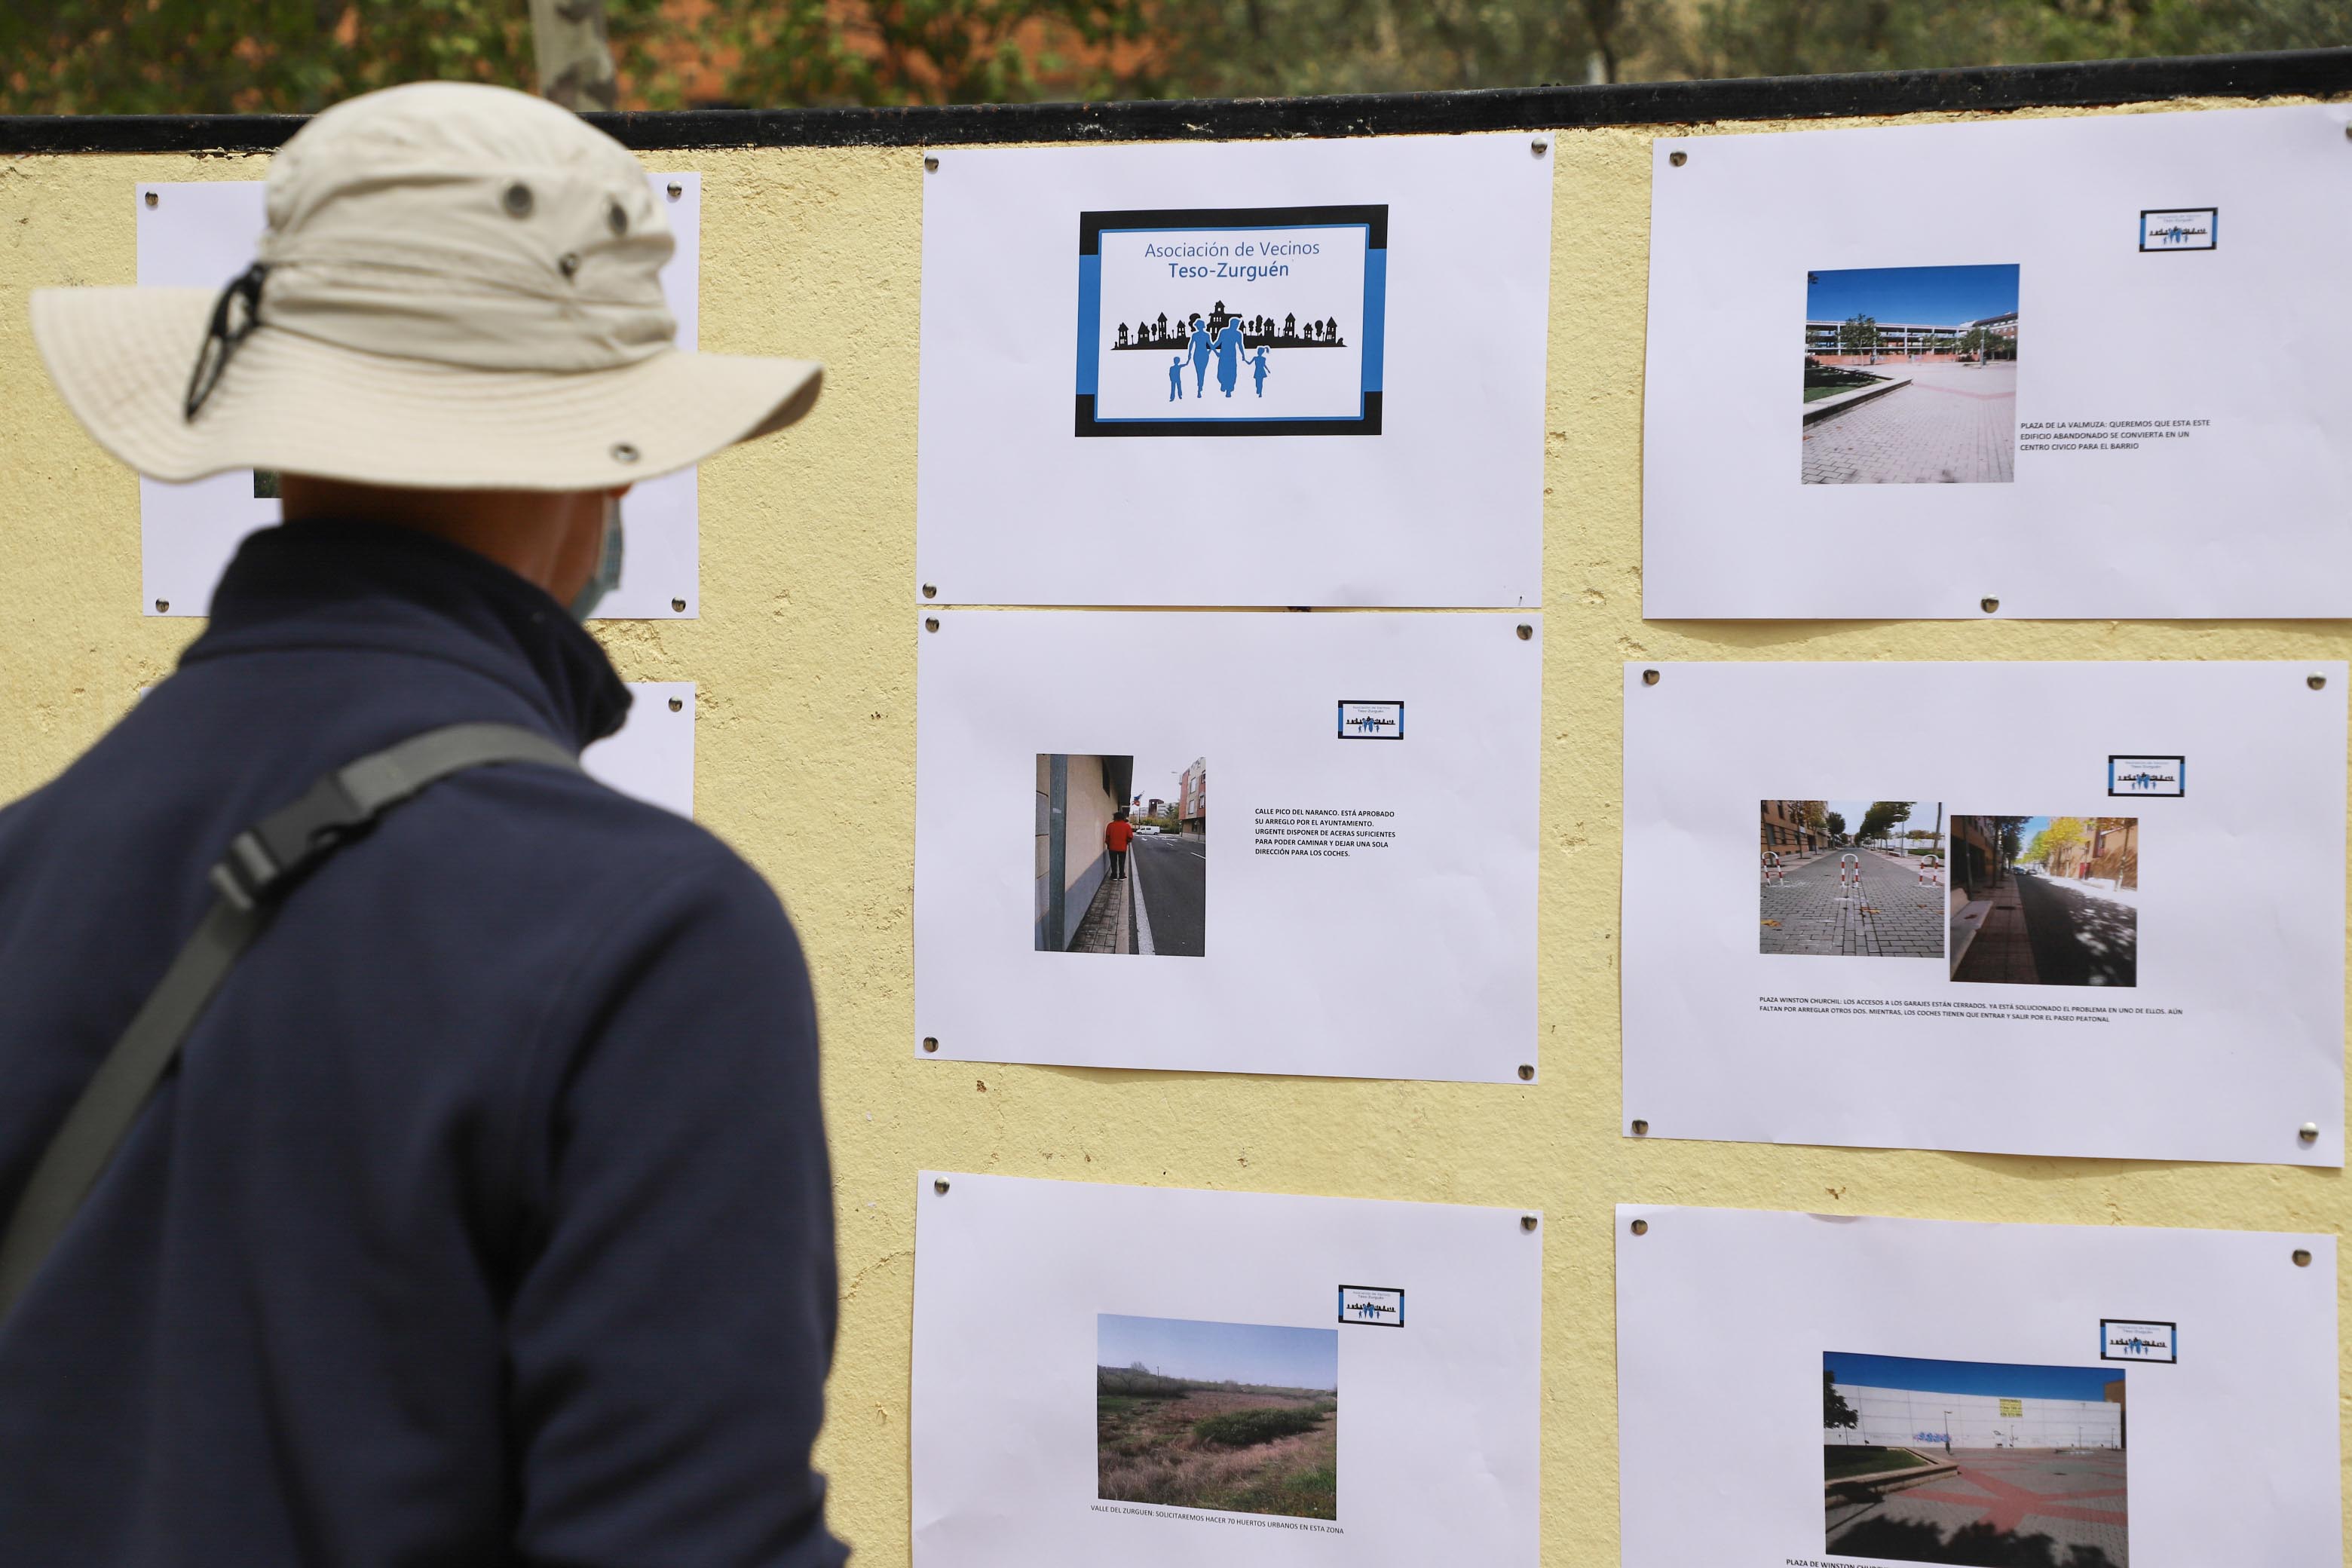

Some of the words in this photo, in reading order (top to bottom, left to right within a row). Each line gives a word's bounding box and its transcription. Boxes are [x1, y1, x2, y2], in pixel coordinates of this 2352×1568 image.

[1144, 241, 1229, 258] Asociación
[1235, 241, 1254, 256] de
[1259, 240, 1320, 256] Vecinos
[1168, 260, 1289, 282] Teso-Zurguén
[2109, 420, 2152, 428] QUEREMOS
[1122, 1507, 1154, 1516] ZURGUEN:
[1155, 1511, 1204, 1521] SOLICITAREMOS
[1205, 1515, 1226, 1524] HACER
[1236, 1519, 1266, 1527] HUERTOS
[1267, 1521, 1298, 1530] URBANOS
[1326, 1526, 1344, 1534] ZONA
